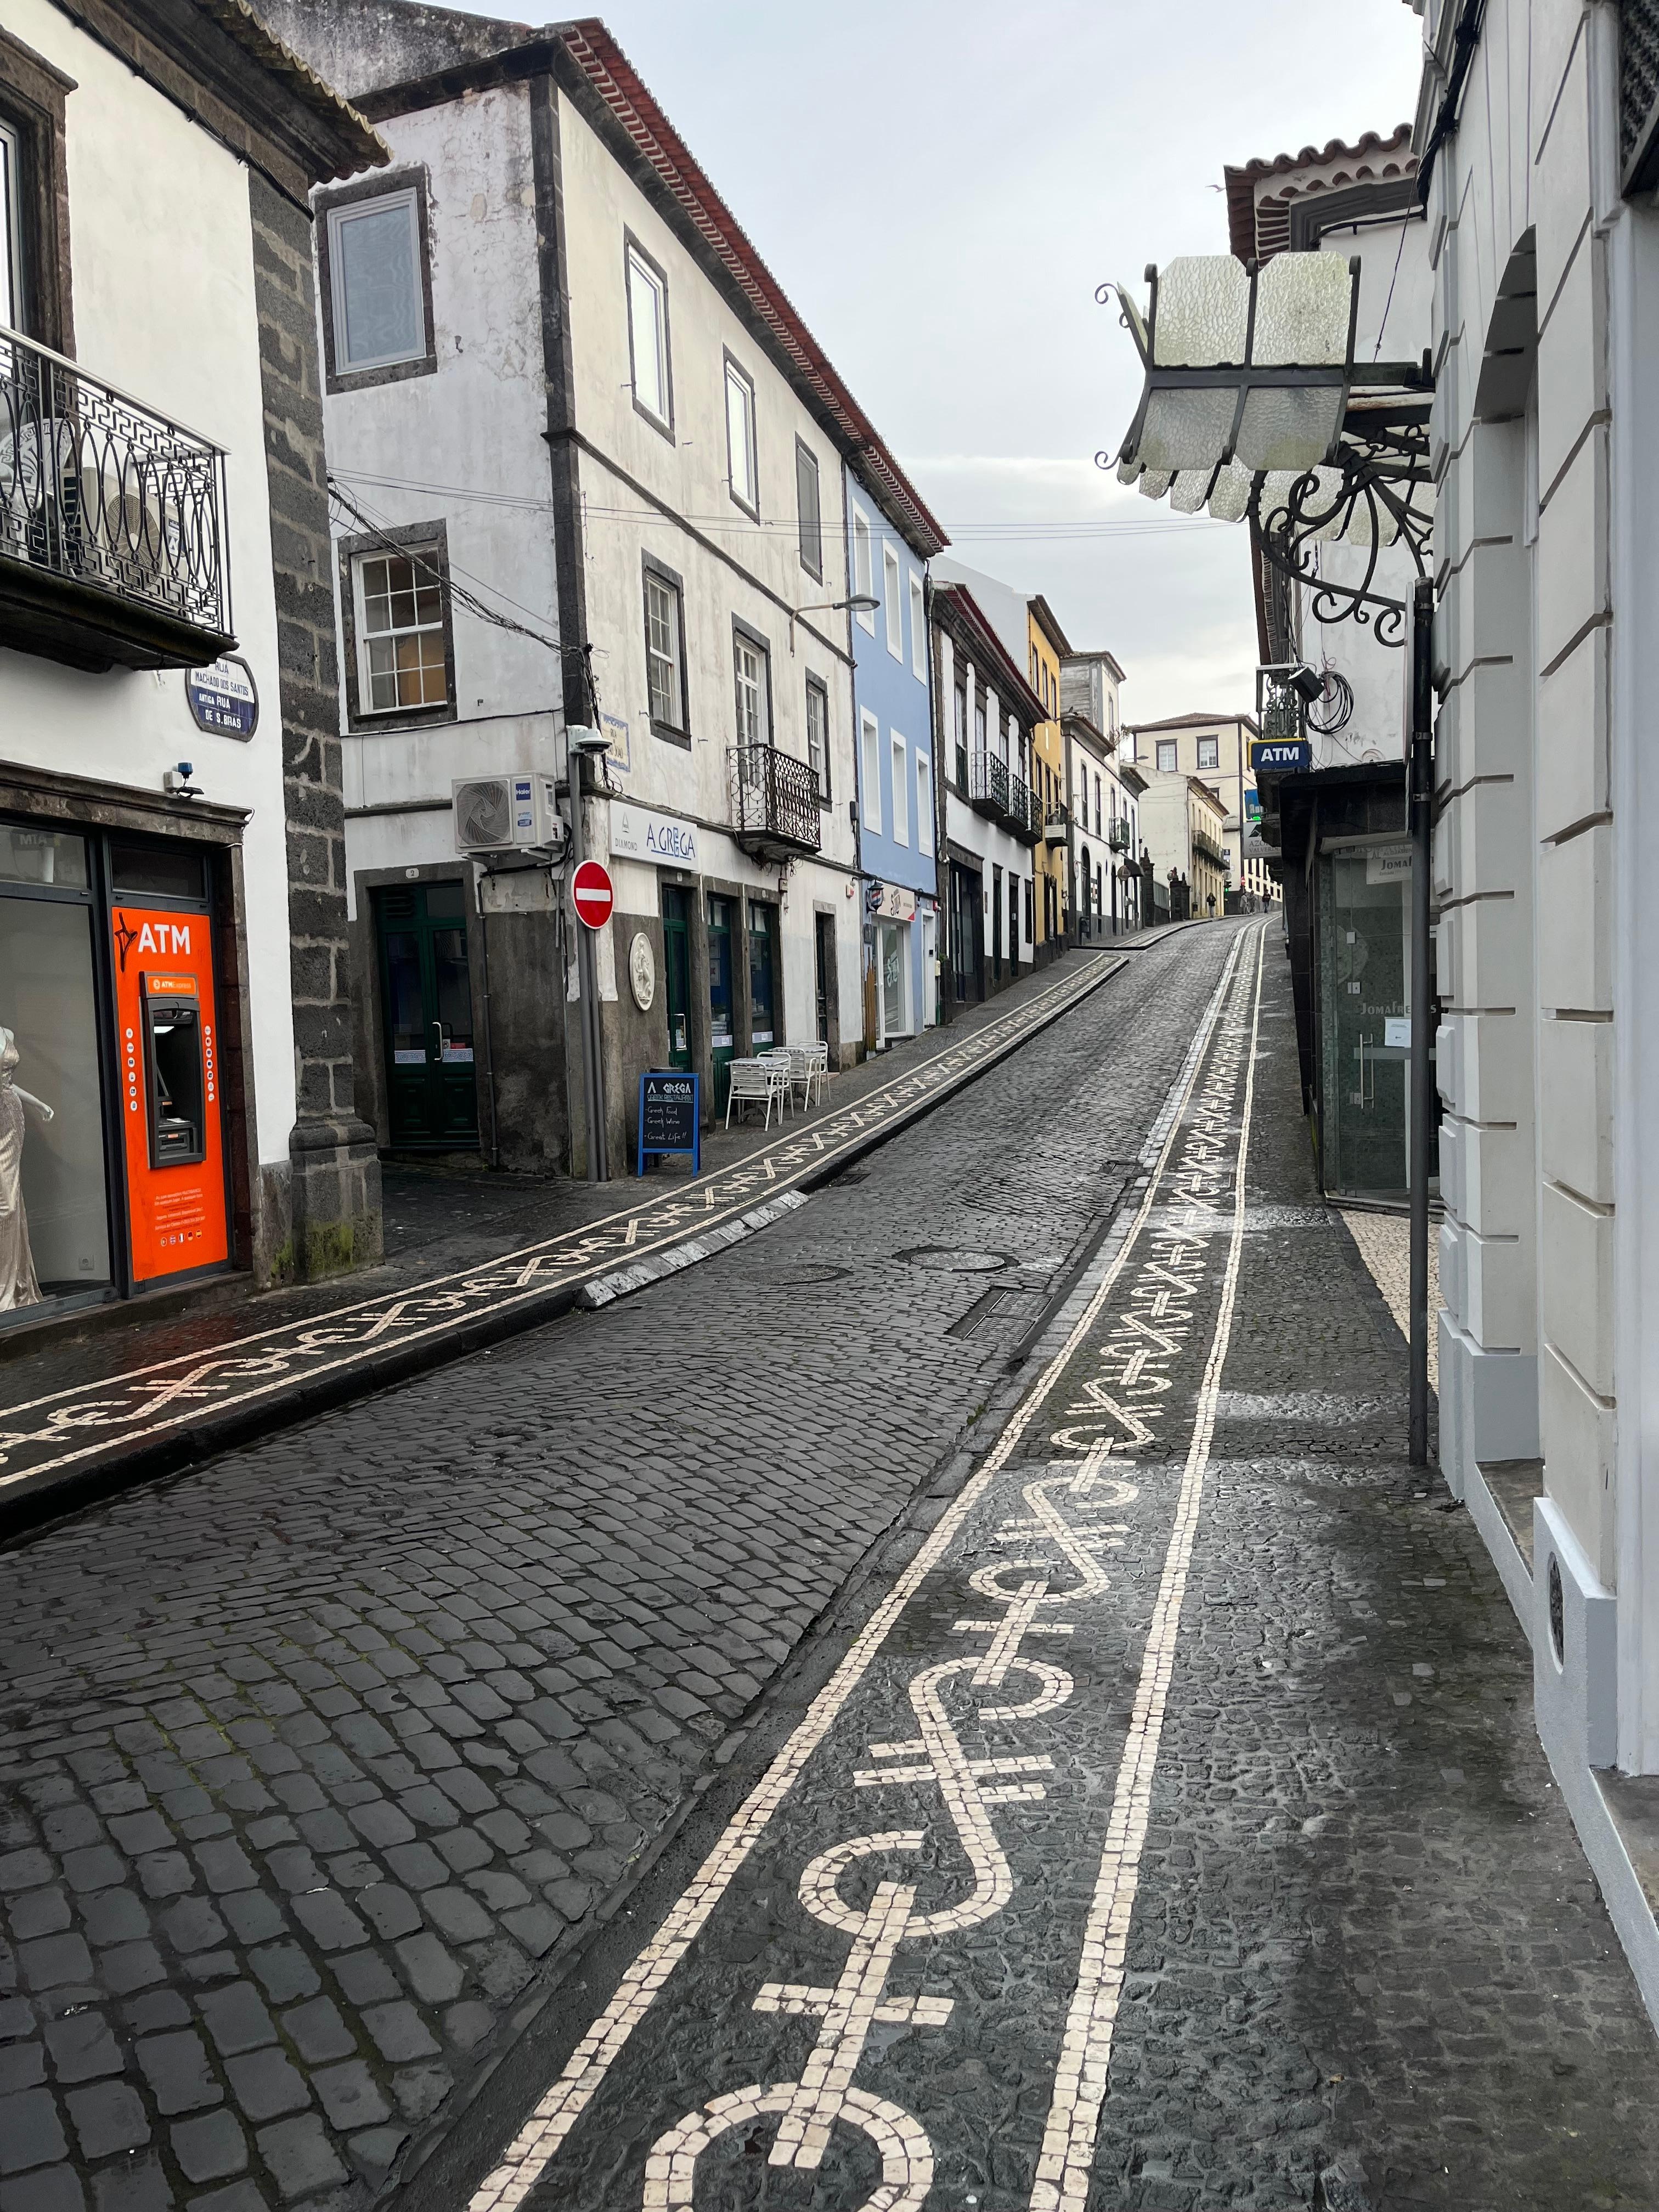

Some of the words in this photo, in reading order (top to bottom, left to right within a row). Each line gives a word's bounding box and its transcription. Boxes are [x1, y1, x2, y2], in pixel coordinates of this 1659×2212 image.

[215, 662, 229, 675] RUA
[195, 671, 219, 687] MACHADO
[220, 679, 229, 691] DOS
[230, 682, 249, 696] SANTOS
[199, 693, 215, 705] ANTIGA
[217, 696, 231, 709] RUA
[205, 709, 213, 721] DE
[1261, 747, 1300, 761] ATM
[615, 838, 637, 851] DIAMOND
[646, 822, 656, 849] A
[658, 826, 696, 858] GREGA
[138, 922, 191, 955] ATM
[647, 1081, 657, 1093] A
[663, 1082, 691, 1094] GREGA
[666, 1106, 678, 1115] Food
